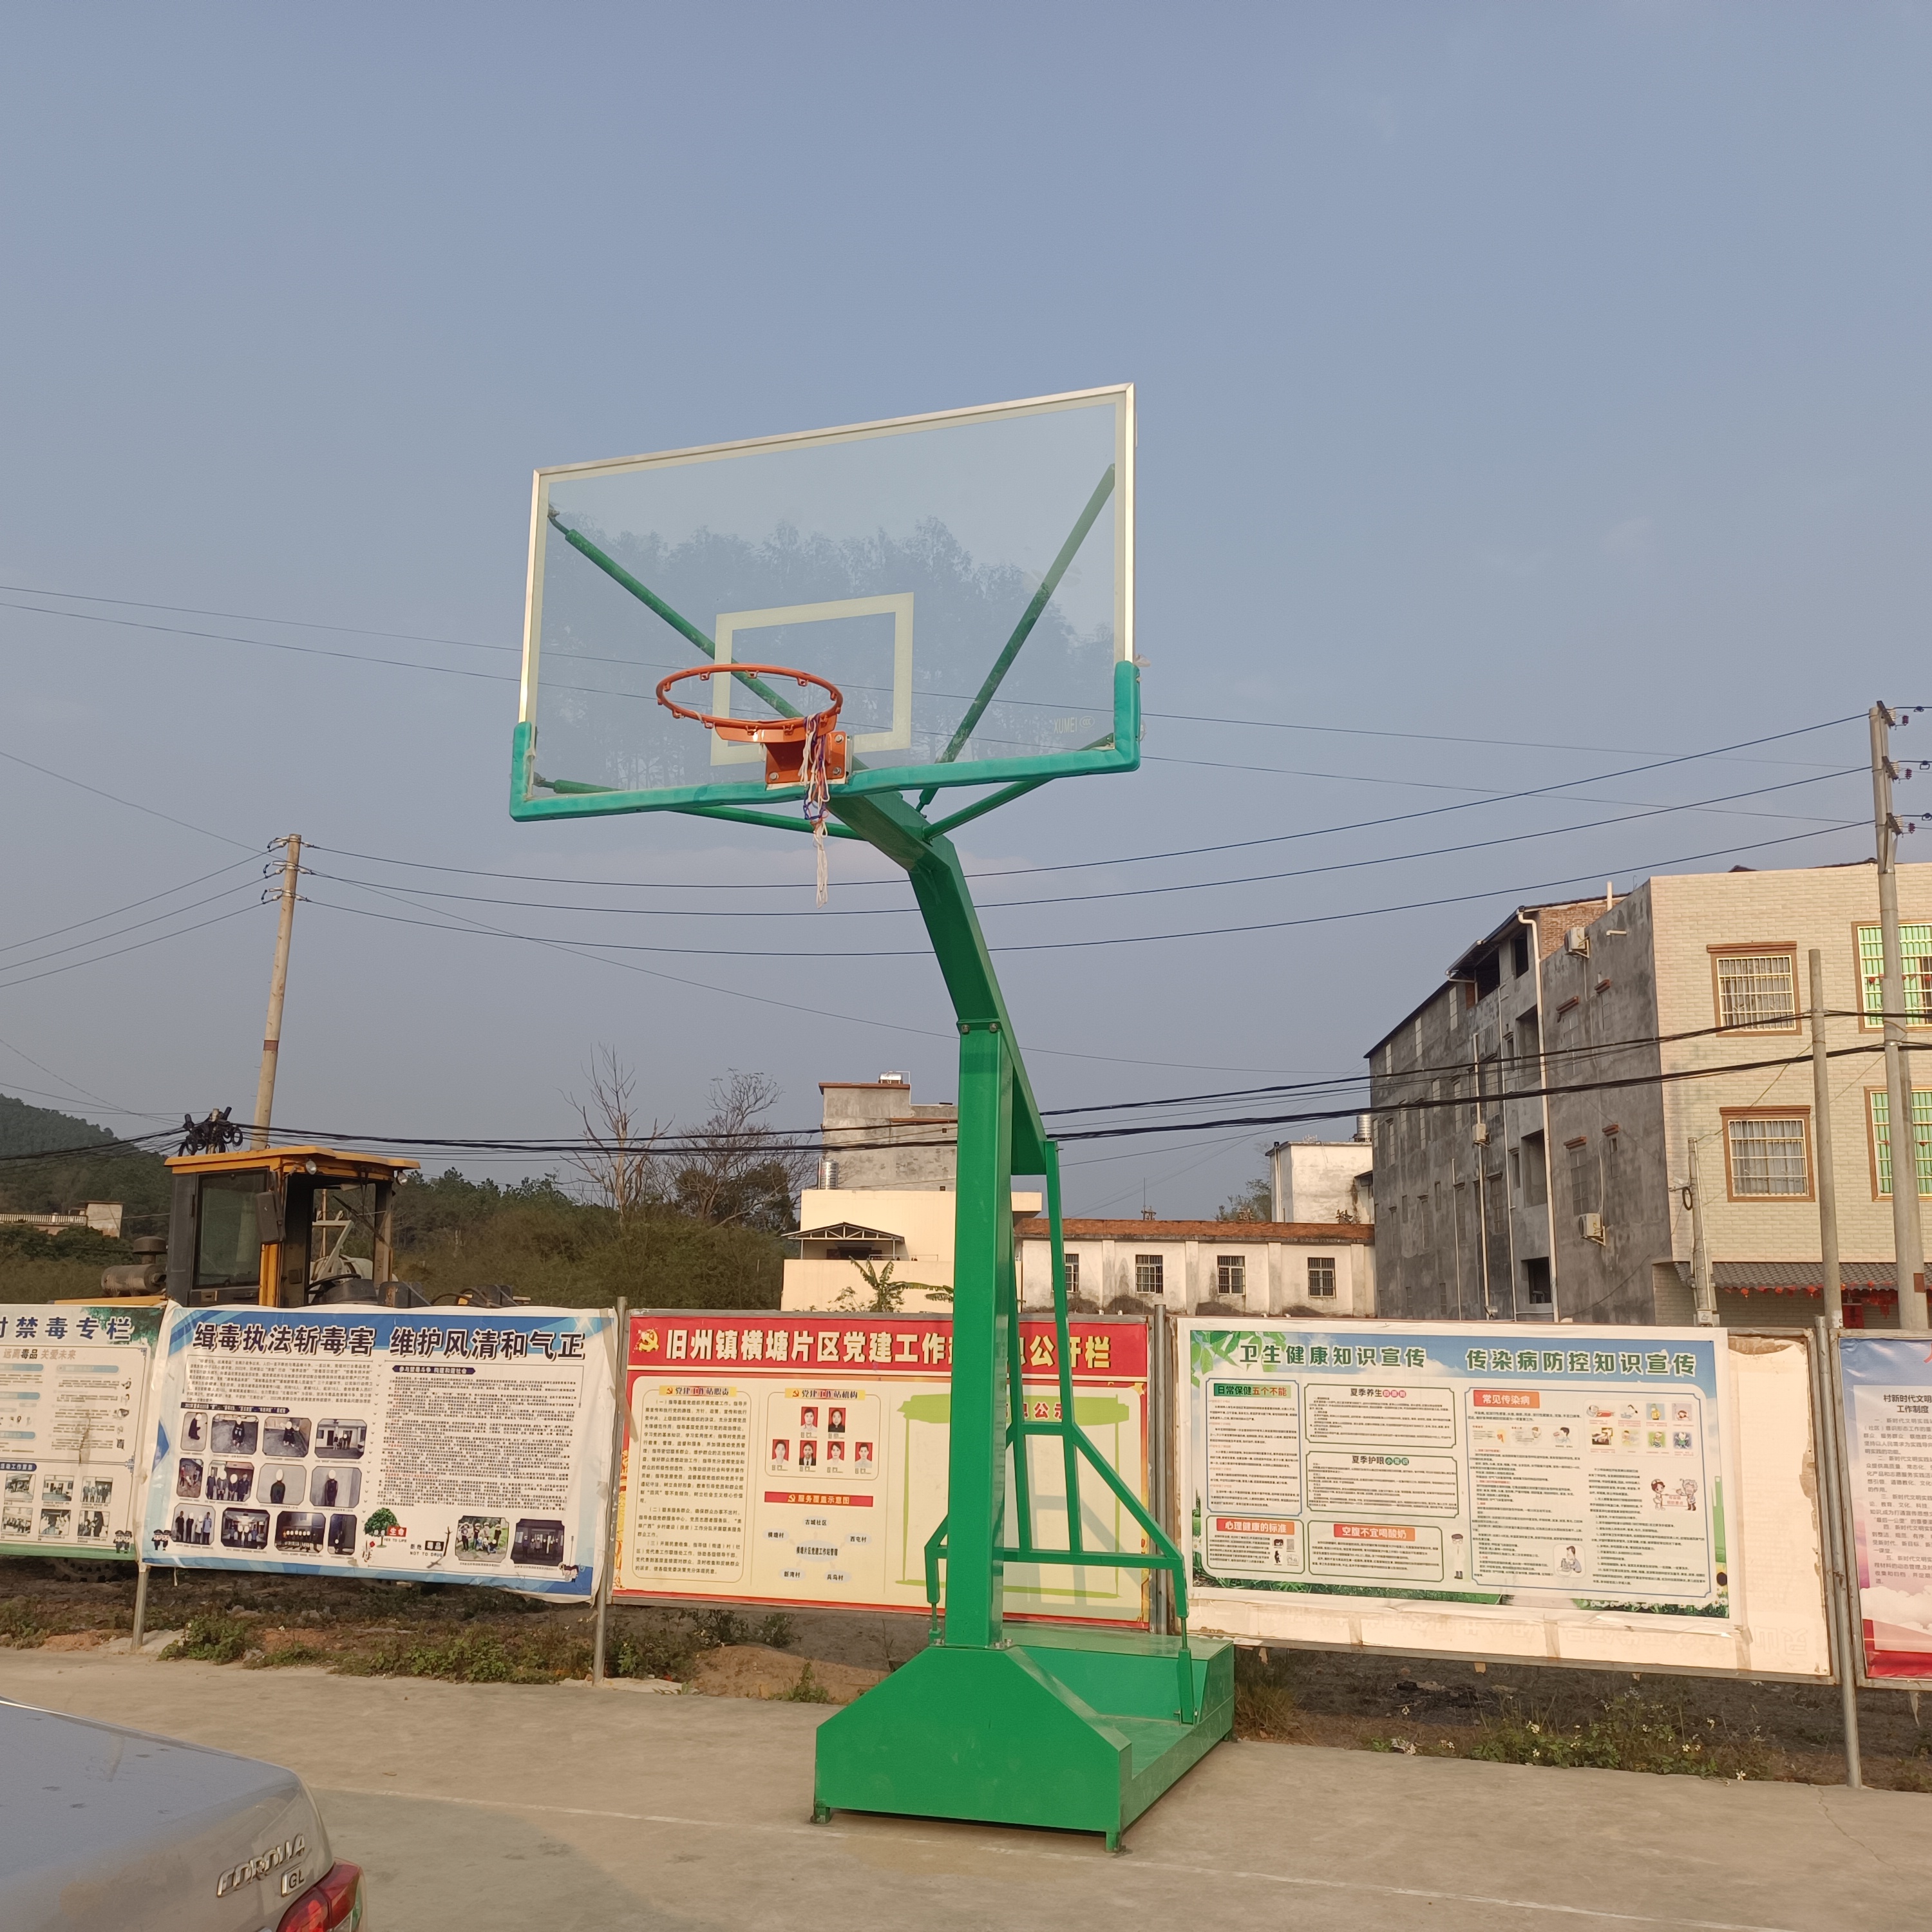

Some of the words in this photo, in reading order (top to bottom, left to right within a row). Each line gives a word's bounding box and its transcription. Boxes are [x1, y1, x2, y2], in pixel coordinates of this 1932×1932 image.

[1054, 717, 1077, 734] XUMEI
[194, 1322, 376, 1356] 缉毒执法斩毒害
[389, 1327, 585, 1359] 维护风清和气正
[1239, 1343, 1426, 1368] 卫生健康知识宣传
[1466, 1348, 1696, 1376] 传染病防控知识宣传
[1218, 1385, 1287, 1396] 日常保健五个不能
[1482, 1394, 1530, 1405] 常见传染病
[1897, 1405, 1929, 1414] 工作制度
[798, 1494, 850, 1505] 服务覆盖示意图
[389, 1526, 404, 1537] 生命
[1225, 1520, 1287, 1533] 心理健康的标准
[1341, 1526, 1407, 1540] 空腹不宜喝酸奶
[216, 1833, 305, 1898] COROLLA
[289, 1869, 305, 1889] GL
